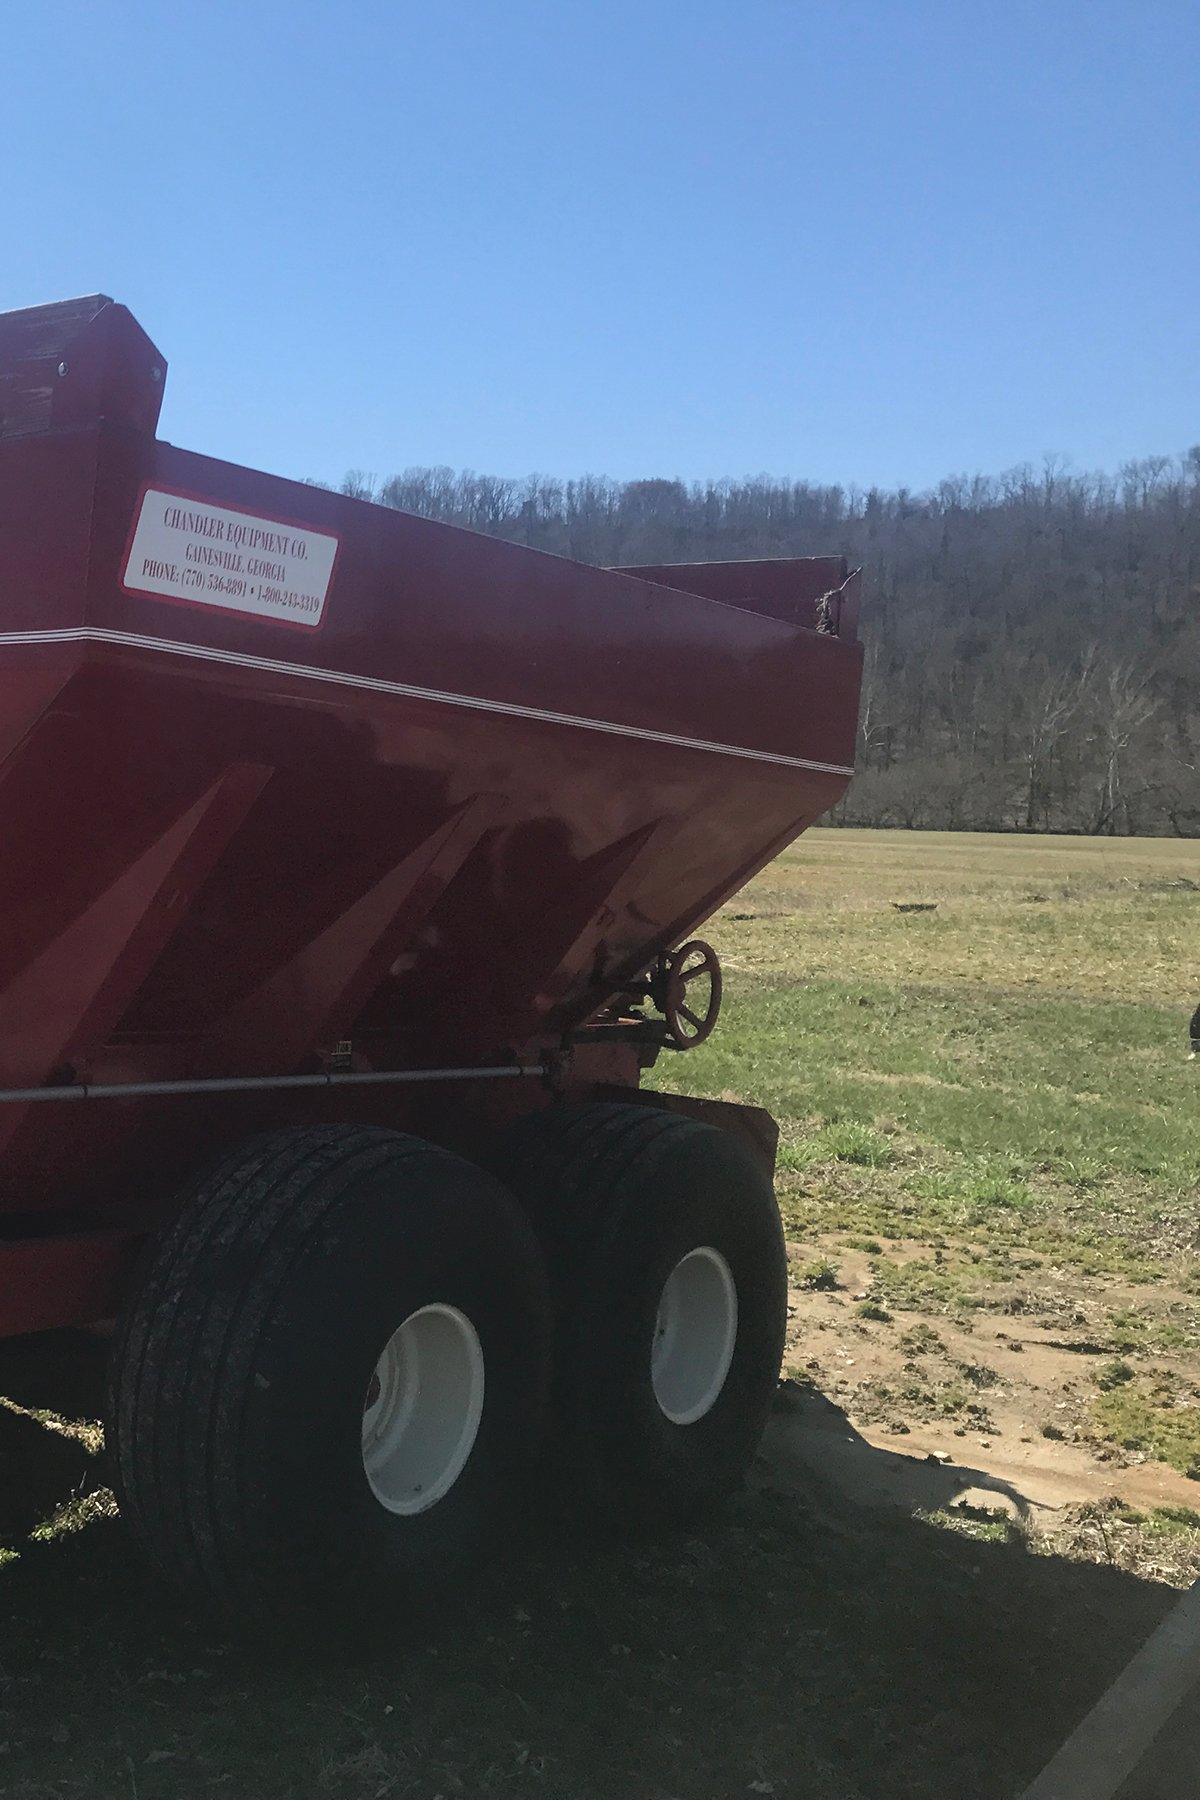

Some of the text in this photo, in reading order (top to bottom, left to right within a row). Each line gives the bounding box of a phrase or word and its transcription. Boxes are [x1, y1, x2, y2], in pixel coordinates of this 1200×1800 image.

[163, 506, 308, 561] CHANDLER EQUIPMENT CO.
[142, 559, 320, 613] PHONE: (770) 536-8891 1-800-243-3319
[247, 559, 286, 583] GEORGIA
